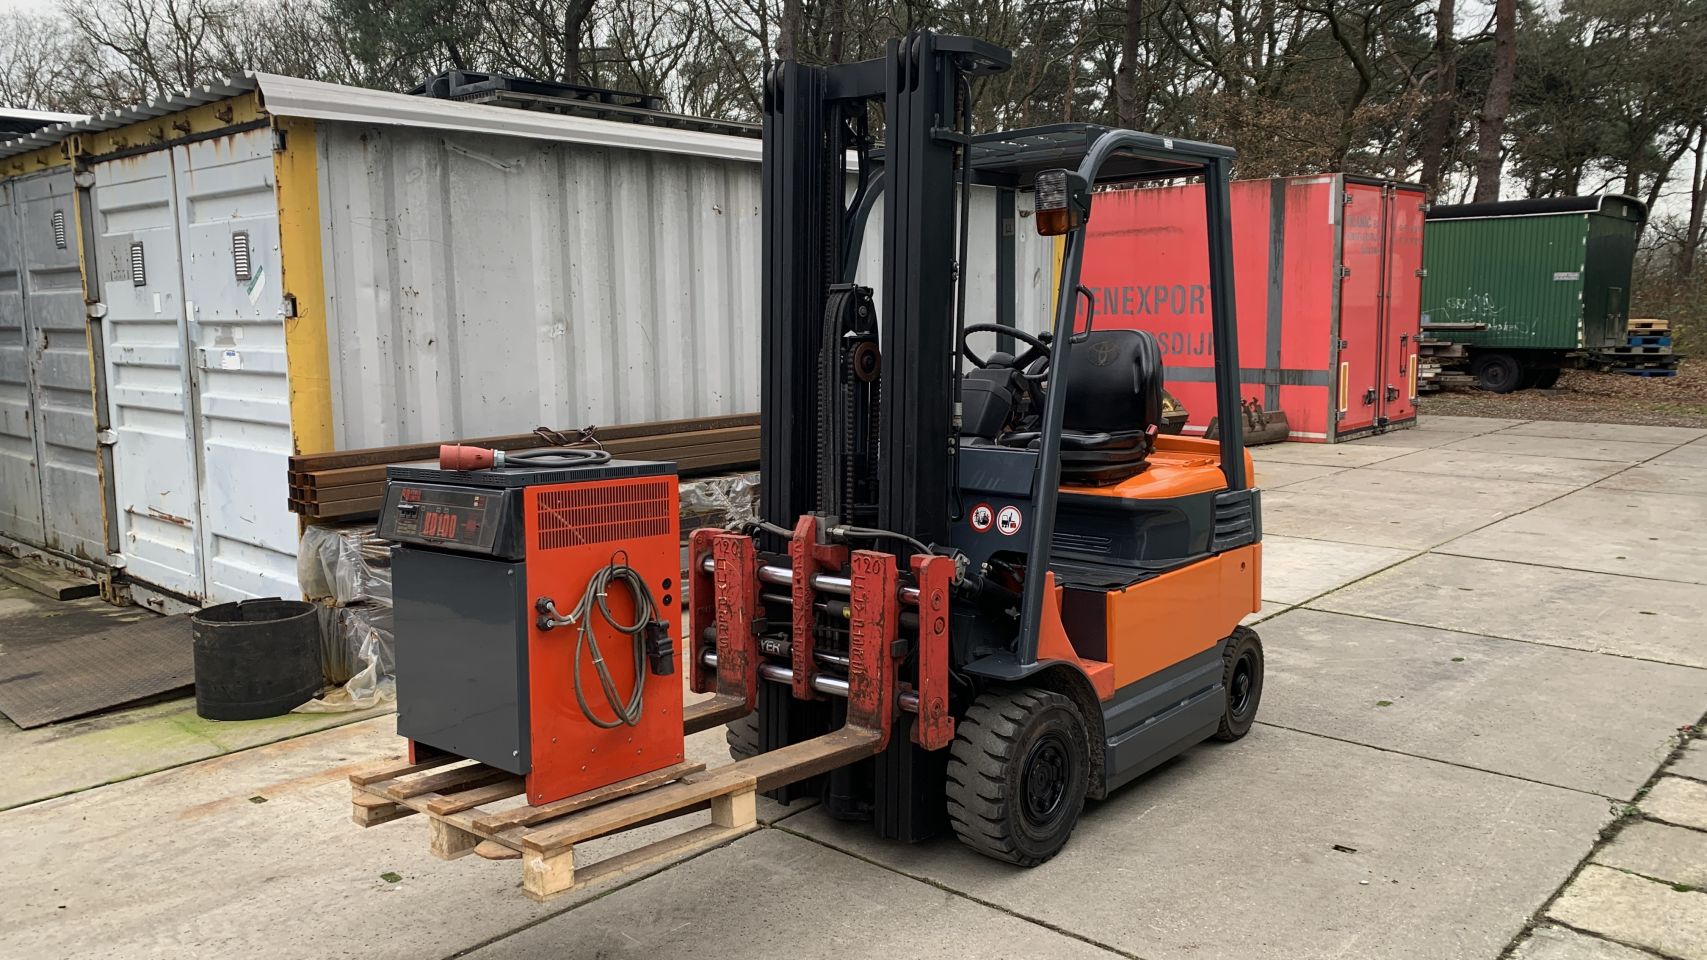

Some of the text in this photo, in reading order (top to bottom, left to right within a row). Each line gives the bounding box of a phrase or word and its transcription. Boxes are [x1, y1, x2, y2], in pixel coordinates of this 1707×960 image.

[1077, 284, 1211, 316] TENEXPOR
[1153, 331, 1213, 356] SDIJ
[714, 540, 738, 556] 120
[854, 556, 881, 575] 120
